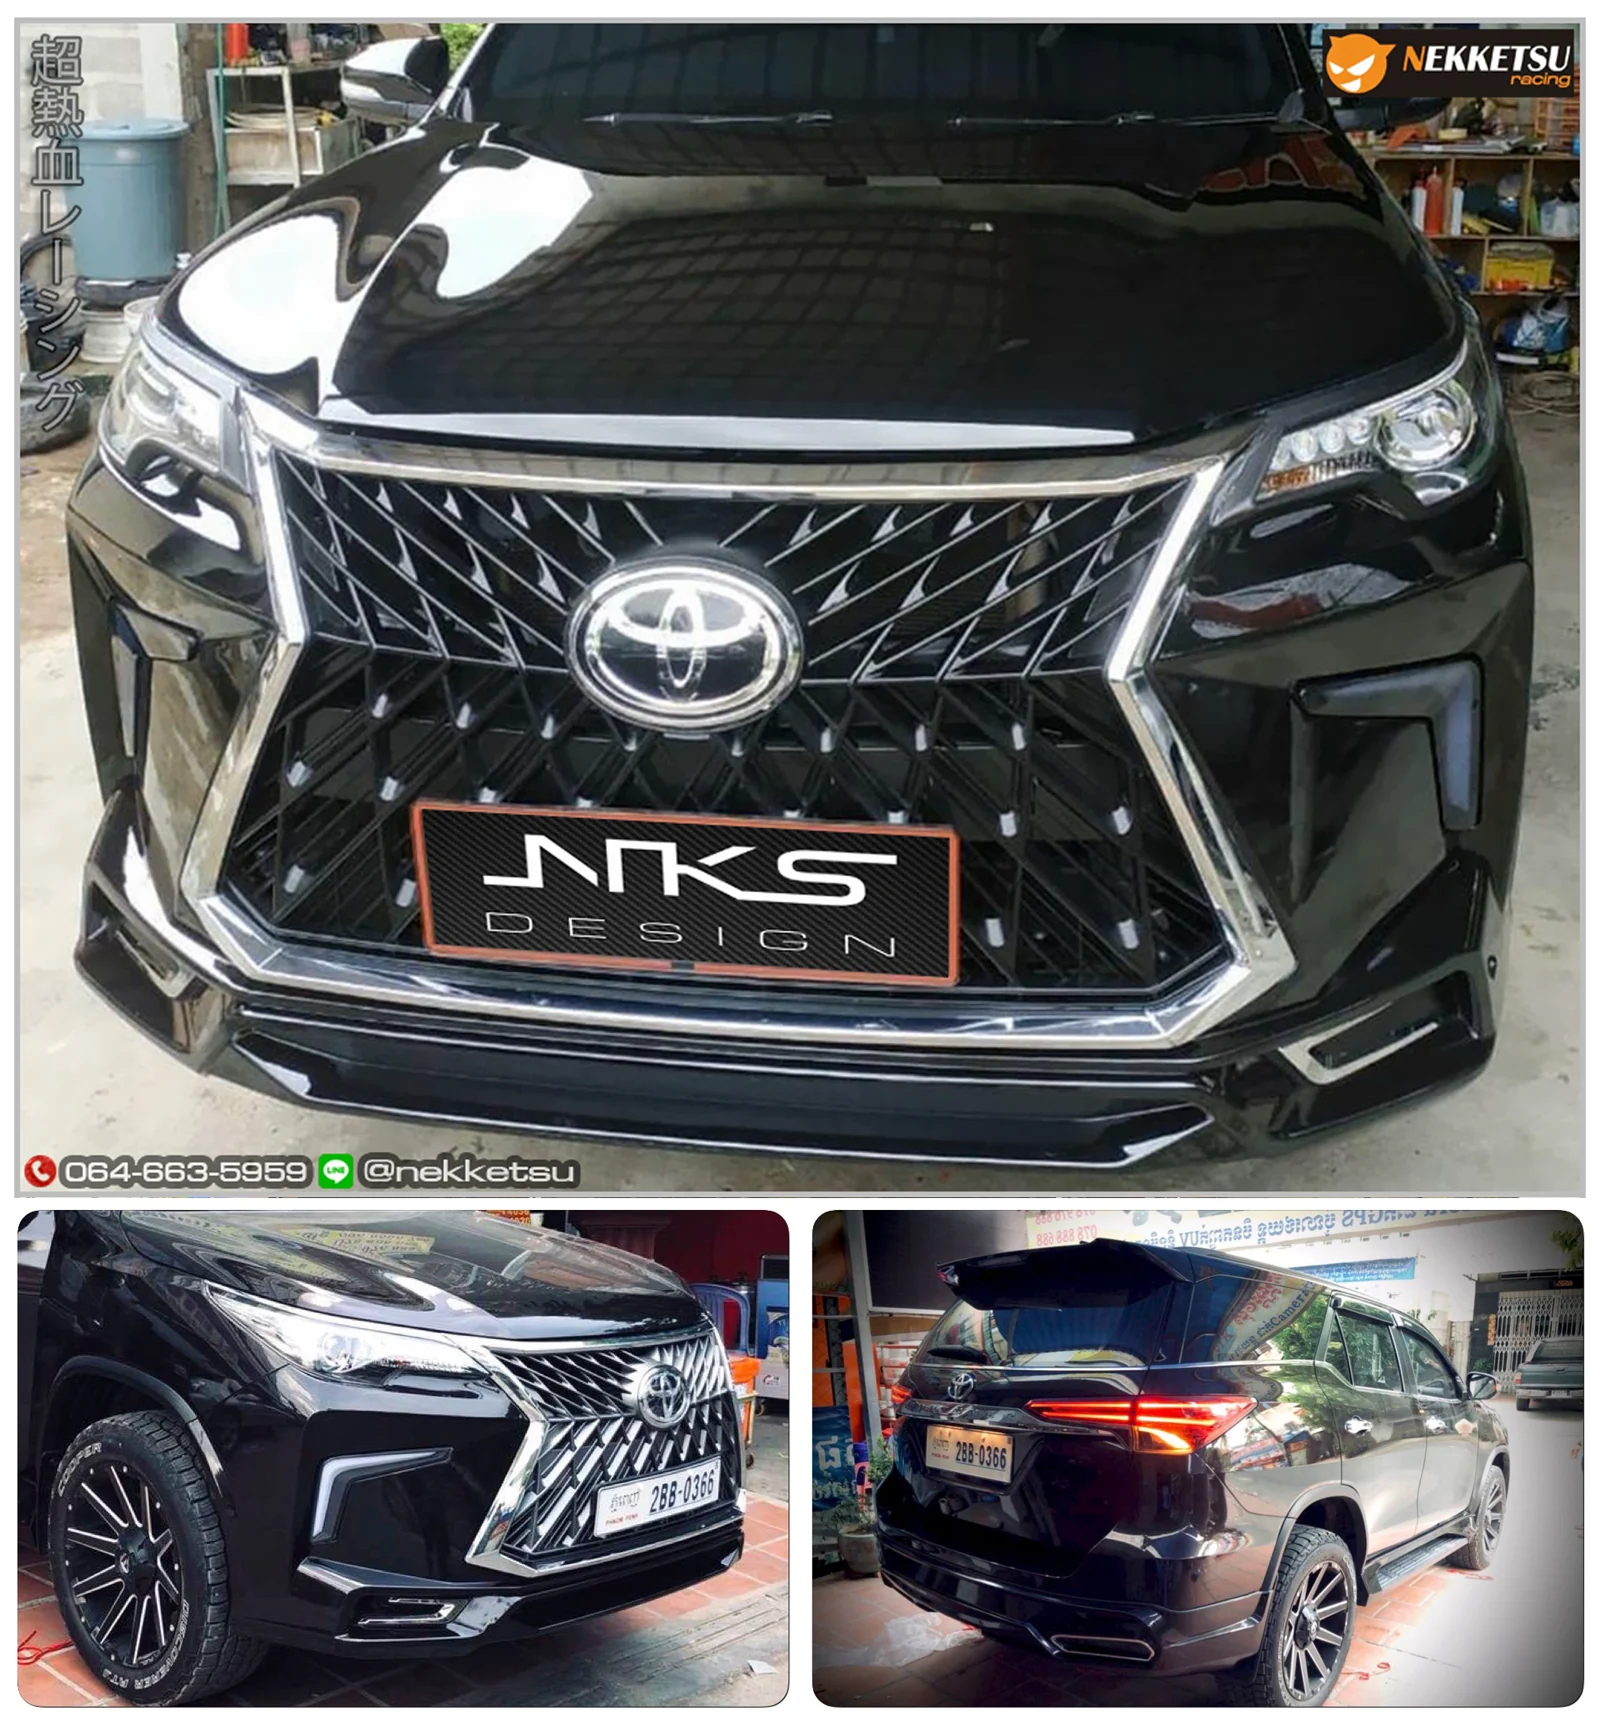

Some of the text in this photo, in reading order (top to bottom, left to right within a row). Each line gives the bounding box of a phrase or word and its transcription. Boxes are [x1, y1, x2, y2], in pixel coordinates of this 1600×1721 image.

[485, 911, 896, 958] DESIGN
[57, 1442, 102, 1497] COOPER
[955, 1441, 1007, 1470] 2BB-0366
[650, 1468, 715, 1514] 2BB-0366
[134, 1598, 190, 1690] DISCOVERER
